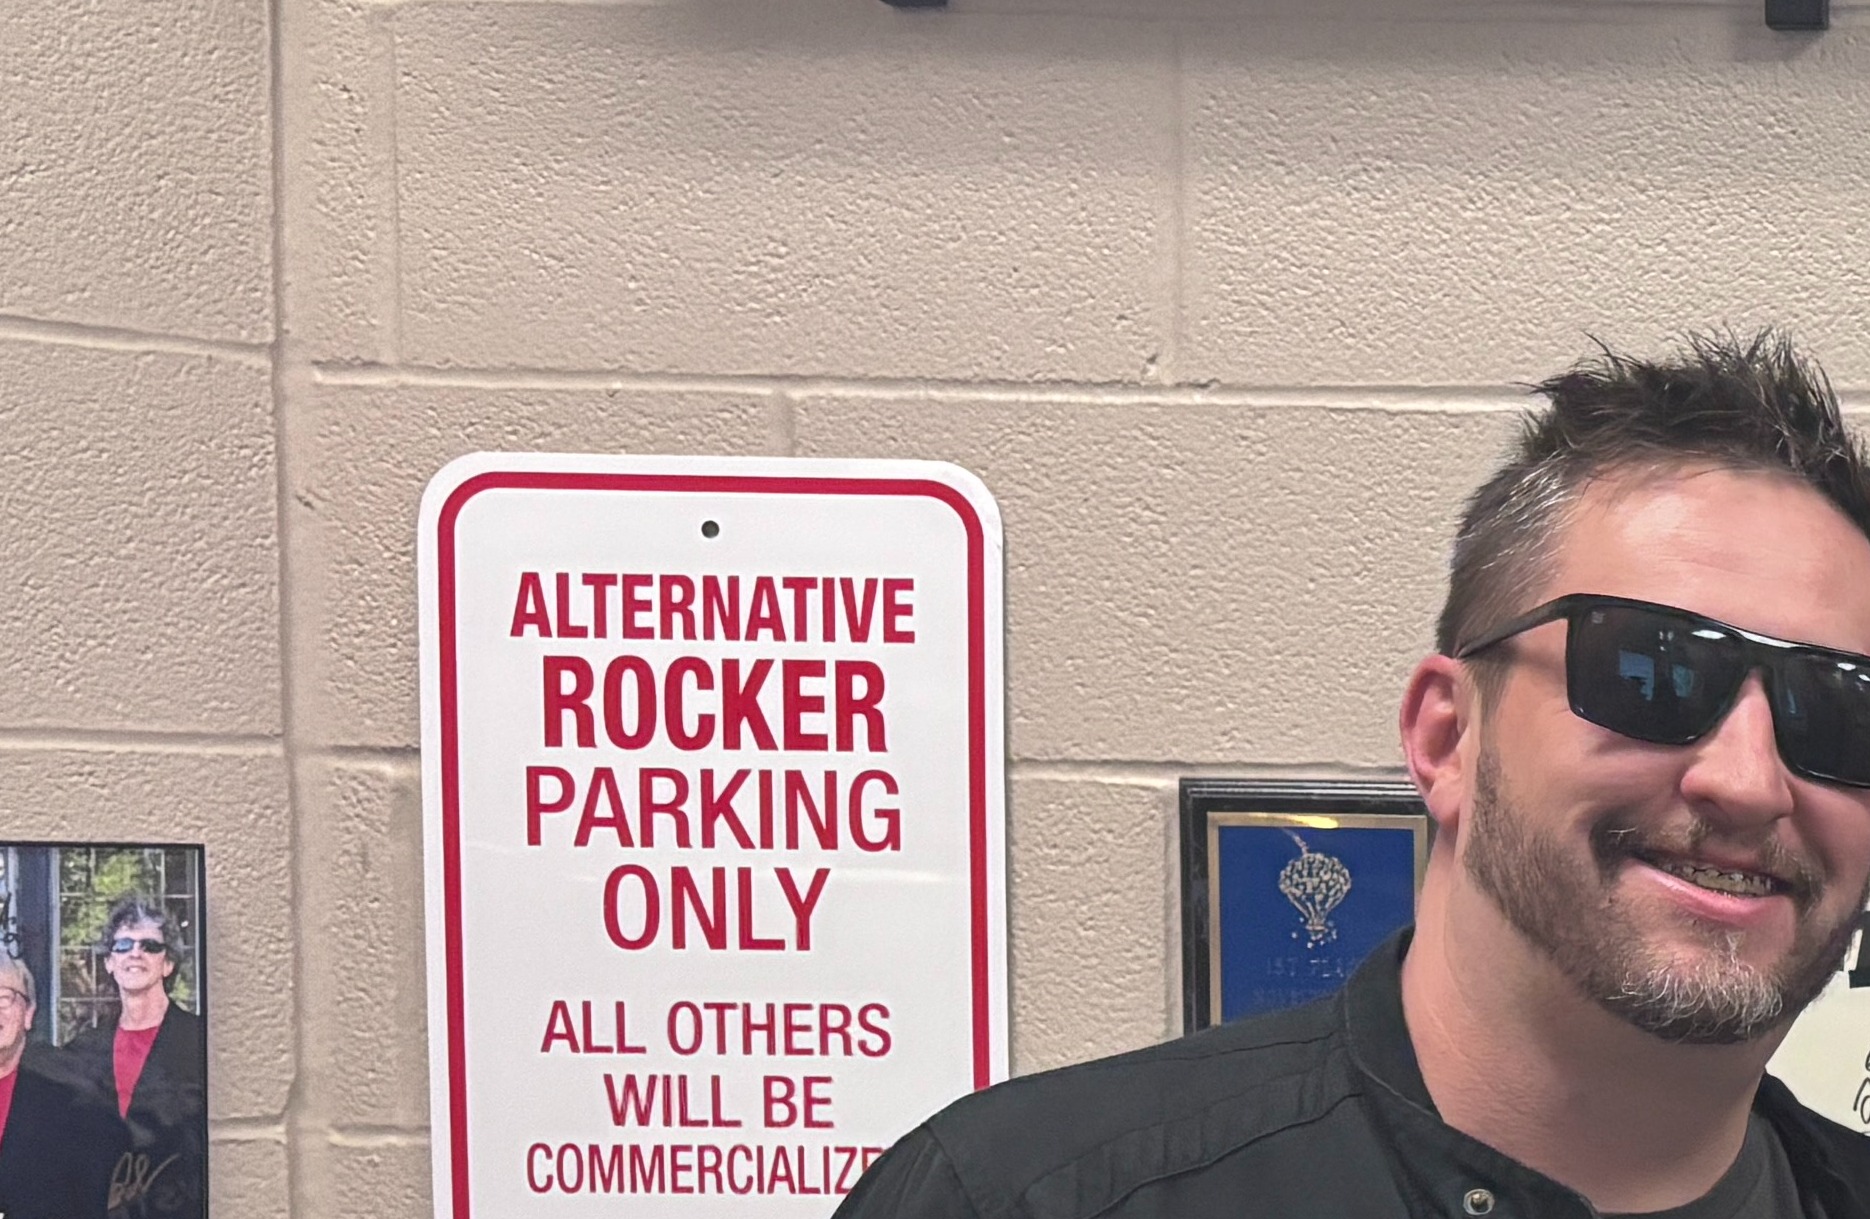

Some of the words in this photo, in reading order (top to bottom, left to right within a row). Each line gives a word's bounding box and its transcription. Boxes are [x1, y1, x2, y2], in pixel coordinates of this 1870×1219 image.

[510, 571, 916, 644] ALTERNATIVE
[542, 655, 888, 754] ROCKER
[525, 765, 902, 853] PARKING
[602, 864, 831, 952] ONLY
[541, 1000, 647, 1056] ALL
[667, 1002, 892, 1058] OTHERS
[603, 1073, 742, 1129] WILL
[763, 1076, 835, 1129] BE
